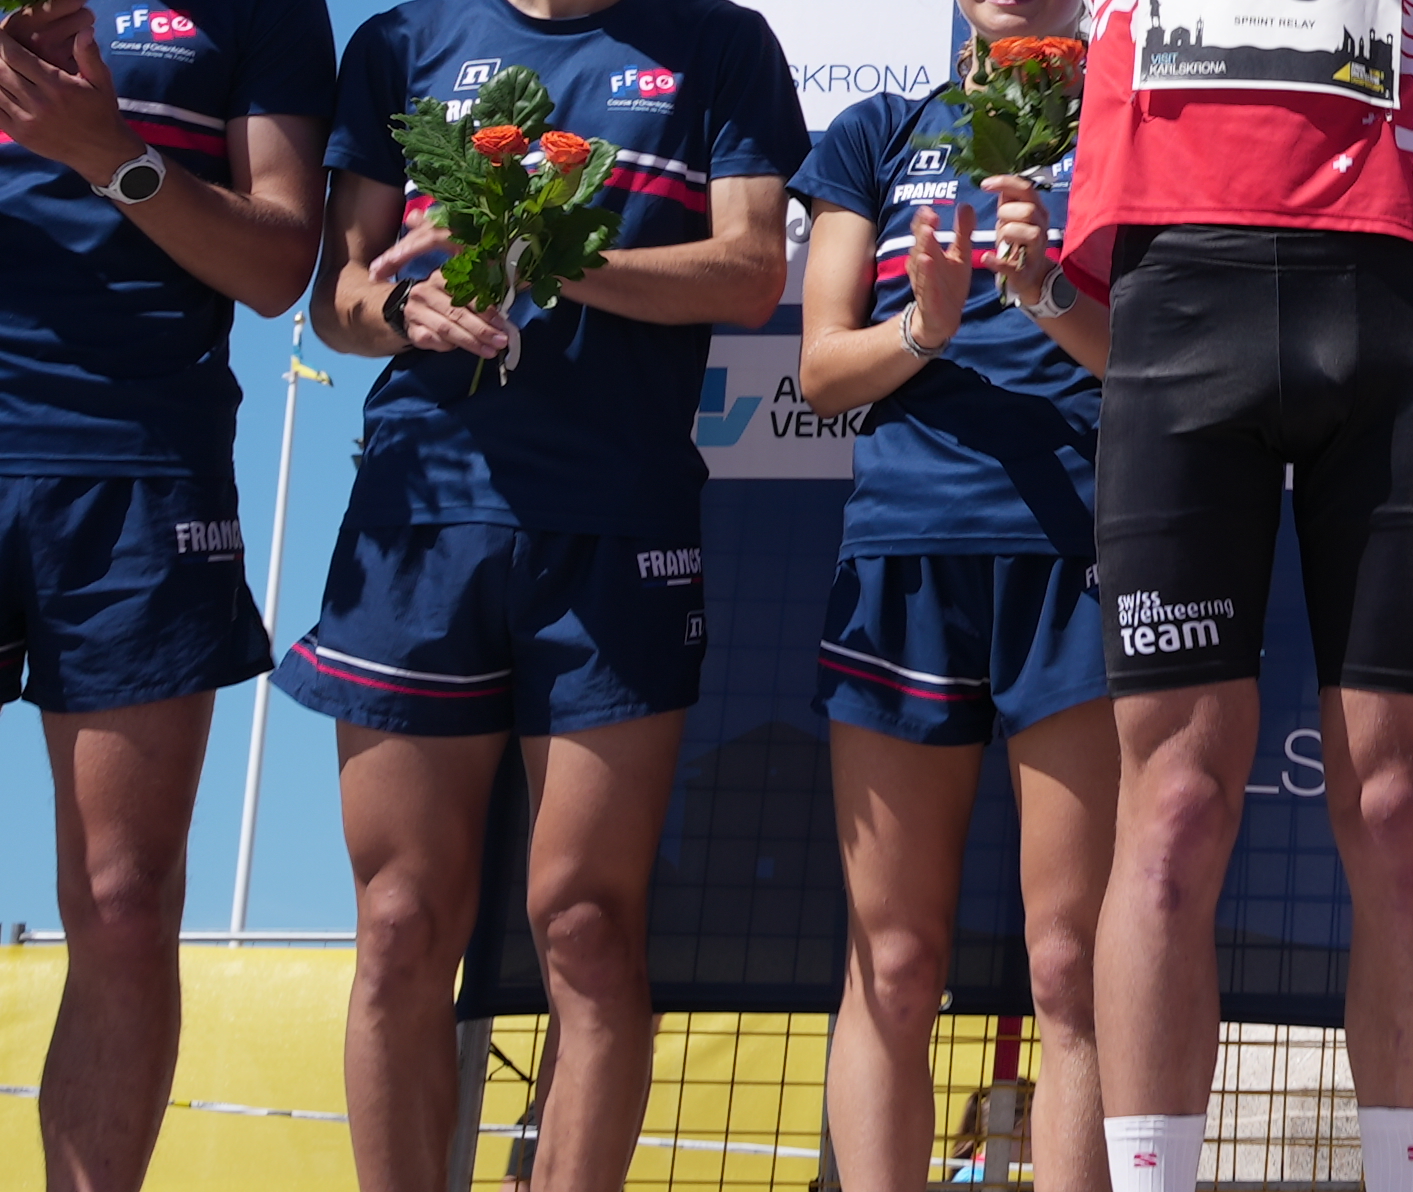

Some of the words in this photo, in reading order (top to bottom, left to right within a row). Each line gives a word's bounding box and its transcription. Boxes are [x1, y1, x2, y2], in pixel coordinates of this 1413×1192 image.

[1234, 15, 1274, 28] SPRINT
[1278, 17, 1316, 30] RELAY
[893, 180, 959, 205] FRANCE
[771, 410, 863, 440] VERK
[1119, 597, 1235, 628] orienteering
[1120, 618, 1220, 657] team
